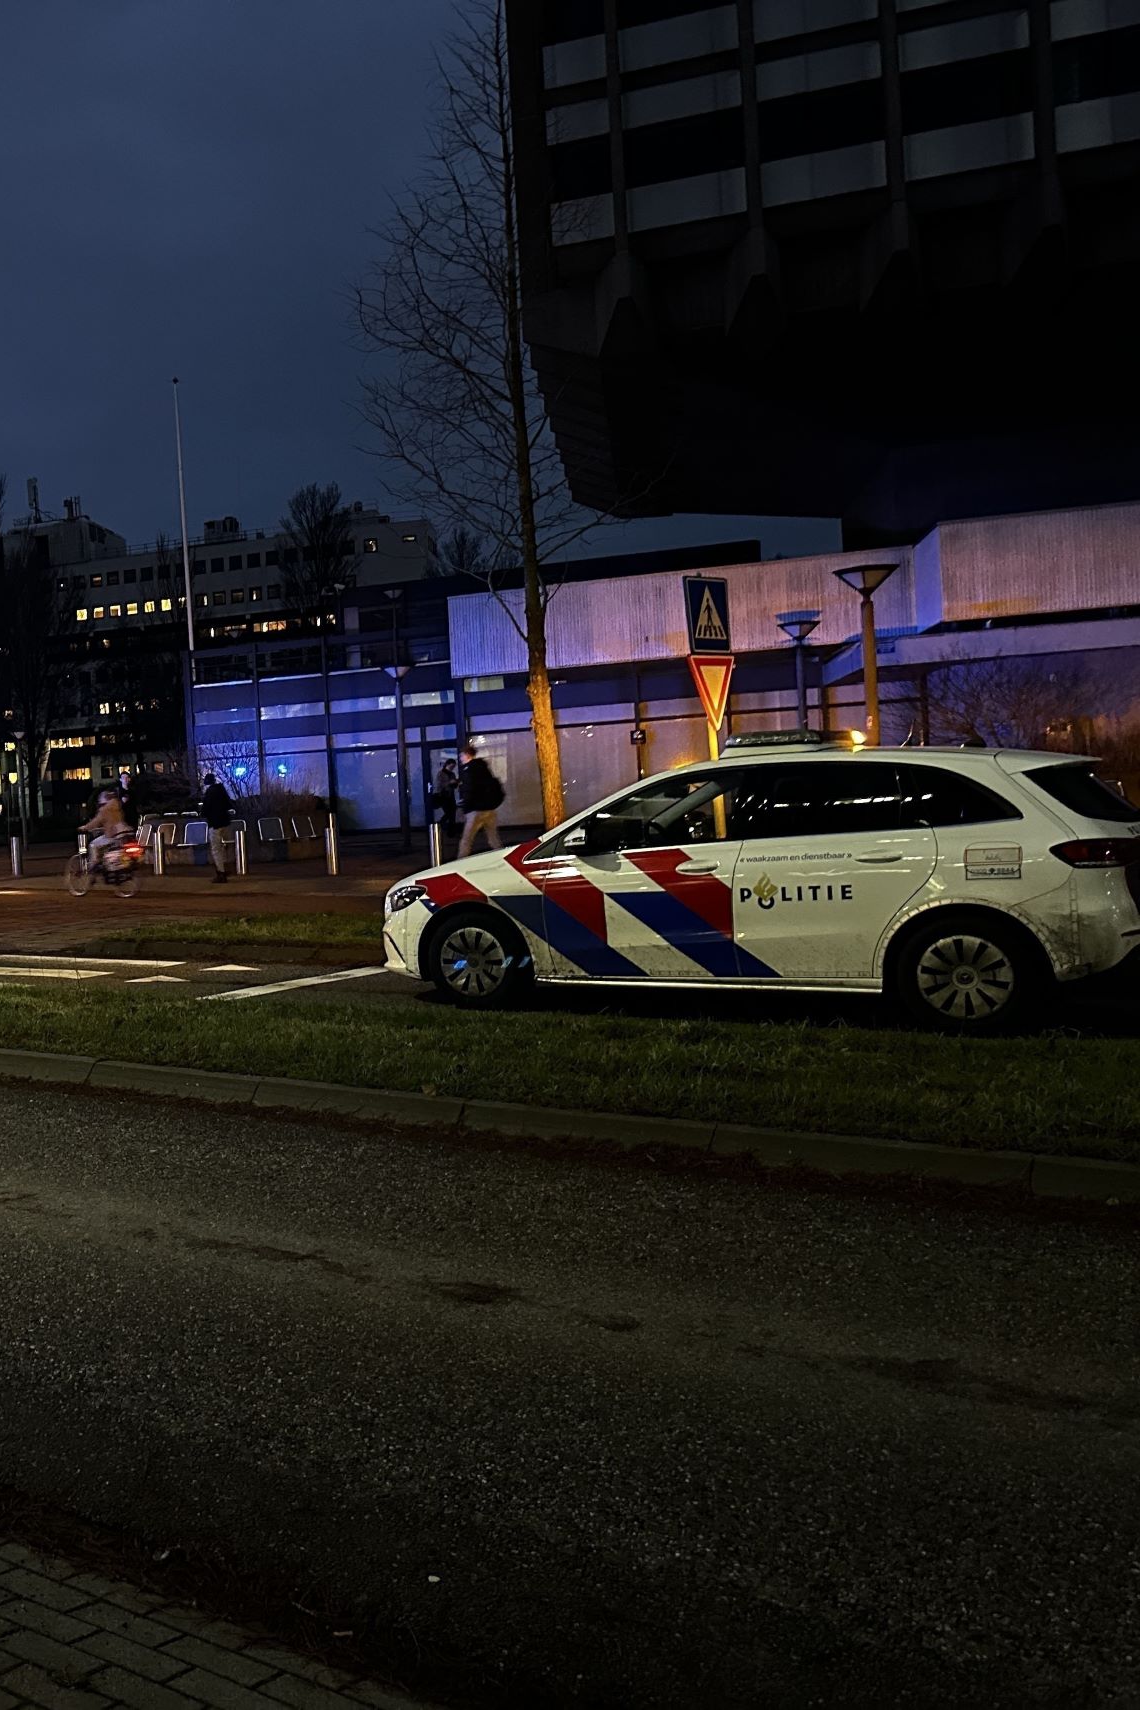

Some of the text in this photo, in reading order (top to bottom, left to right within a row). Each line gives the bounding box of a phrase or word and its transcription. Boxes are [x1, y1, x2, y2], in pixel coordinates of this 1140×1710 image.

[746, 855, 789, 863] waakzaam
[801, 852, 846, 860] dienstbaar
[740, 884, 853, 910] POLITIE
